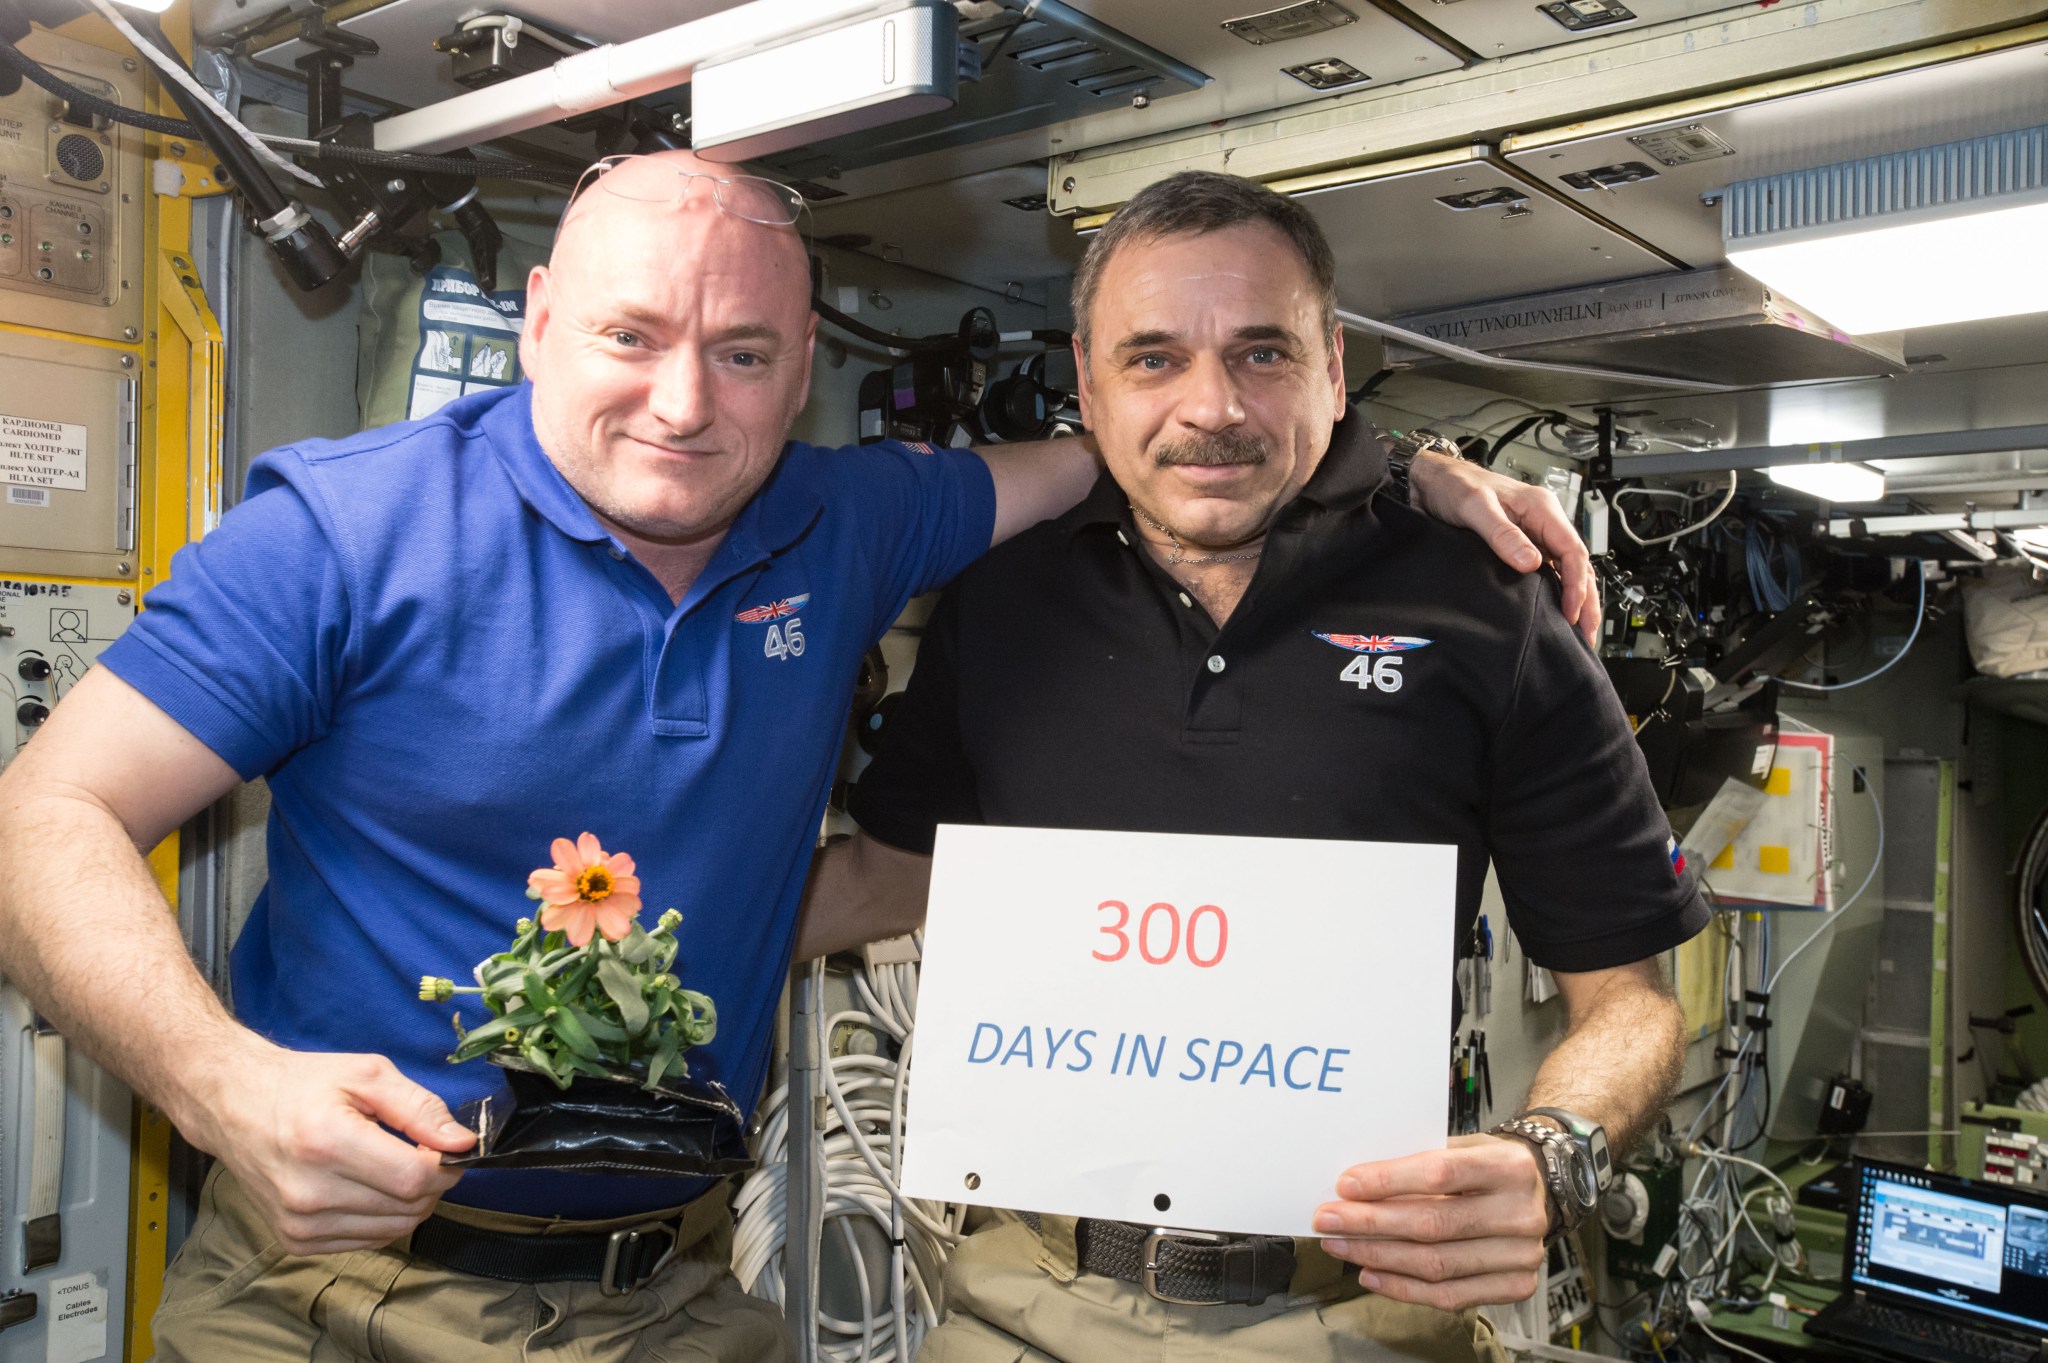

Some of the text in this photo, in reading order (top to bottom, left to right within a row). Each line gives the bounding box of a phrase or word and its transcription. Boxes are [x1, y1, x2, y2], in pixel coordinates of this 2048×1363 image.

[0, 129, 22, 141] UNIT
[45, 206, 79, 220] CHANNEL
[1635, 298, 1653, 310] THE
[1475, 300, 1604, 334] INTERNATIONAL
[1424, 319, 1471, 339] ATLAS
[2, 417, 62, 433] КАРДИОМЕД
[3, 427, 61, 441] CARDIOMED
[10, 451, 55, 463] HLTE SET
[24, 442, 83, 457] ХОЛТЕР-ЭКГ
[9, 473, 55, 485] HLTA SET
[27, 464, 80, 480] ХОЛТЕР-АД
[764, 617, 806, 662] 46
[1339, 654, 1403, 693] 46
[1091, 899, 1230, 969] 300
[967, 1022, 1352, 1093] DAYS IN SPACE
[65, 1299, 91, 1311] Cables
[58, 1306, 98, 1321] Electrodes
